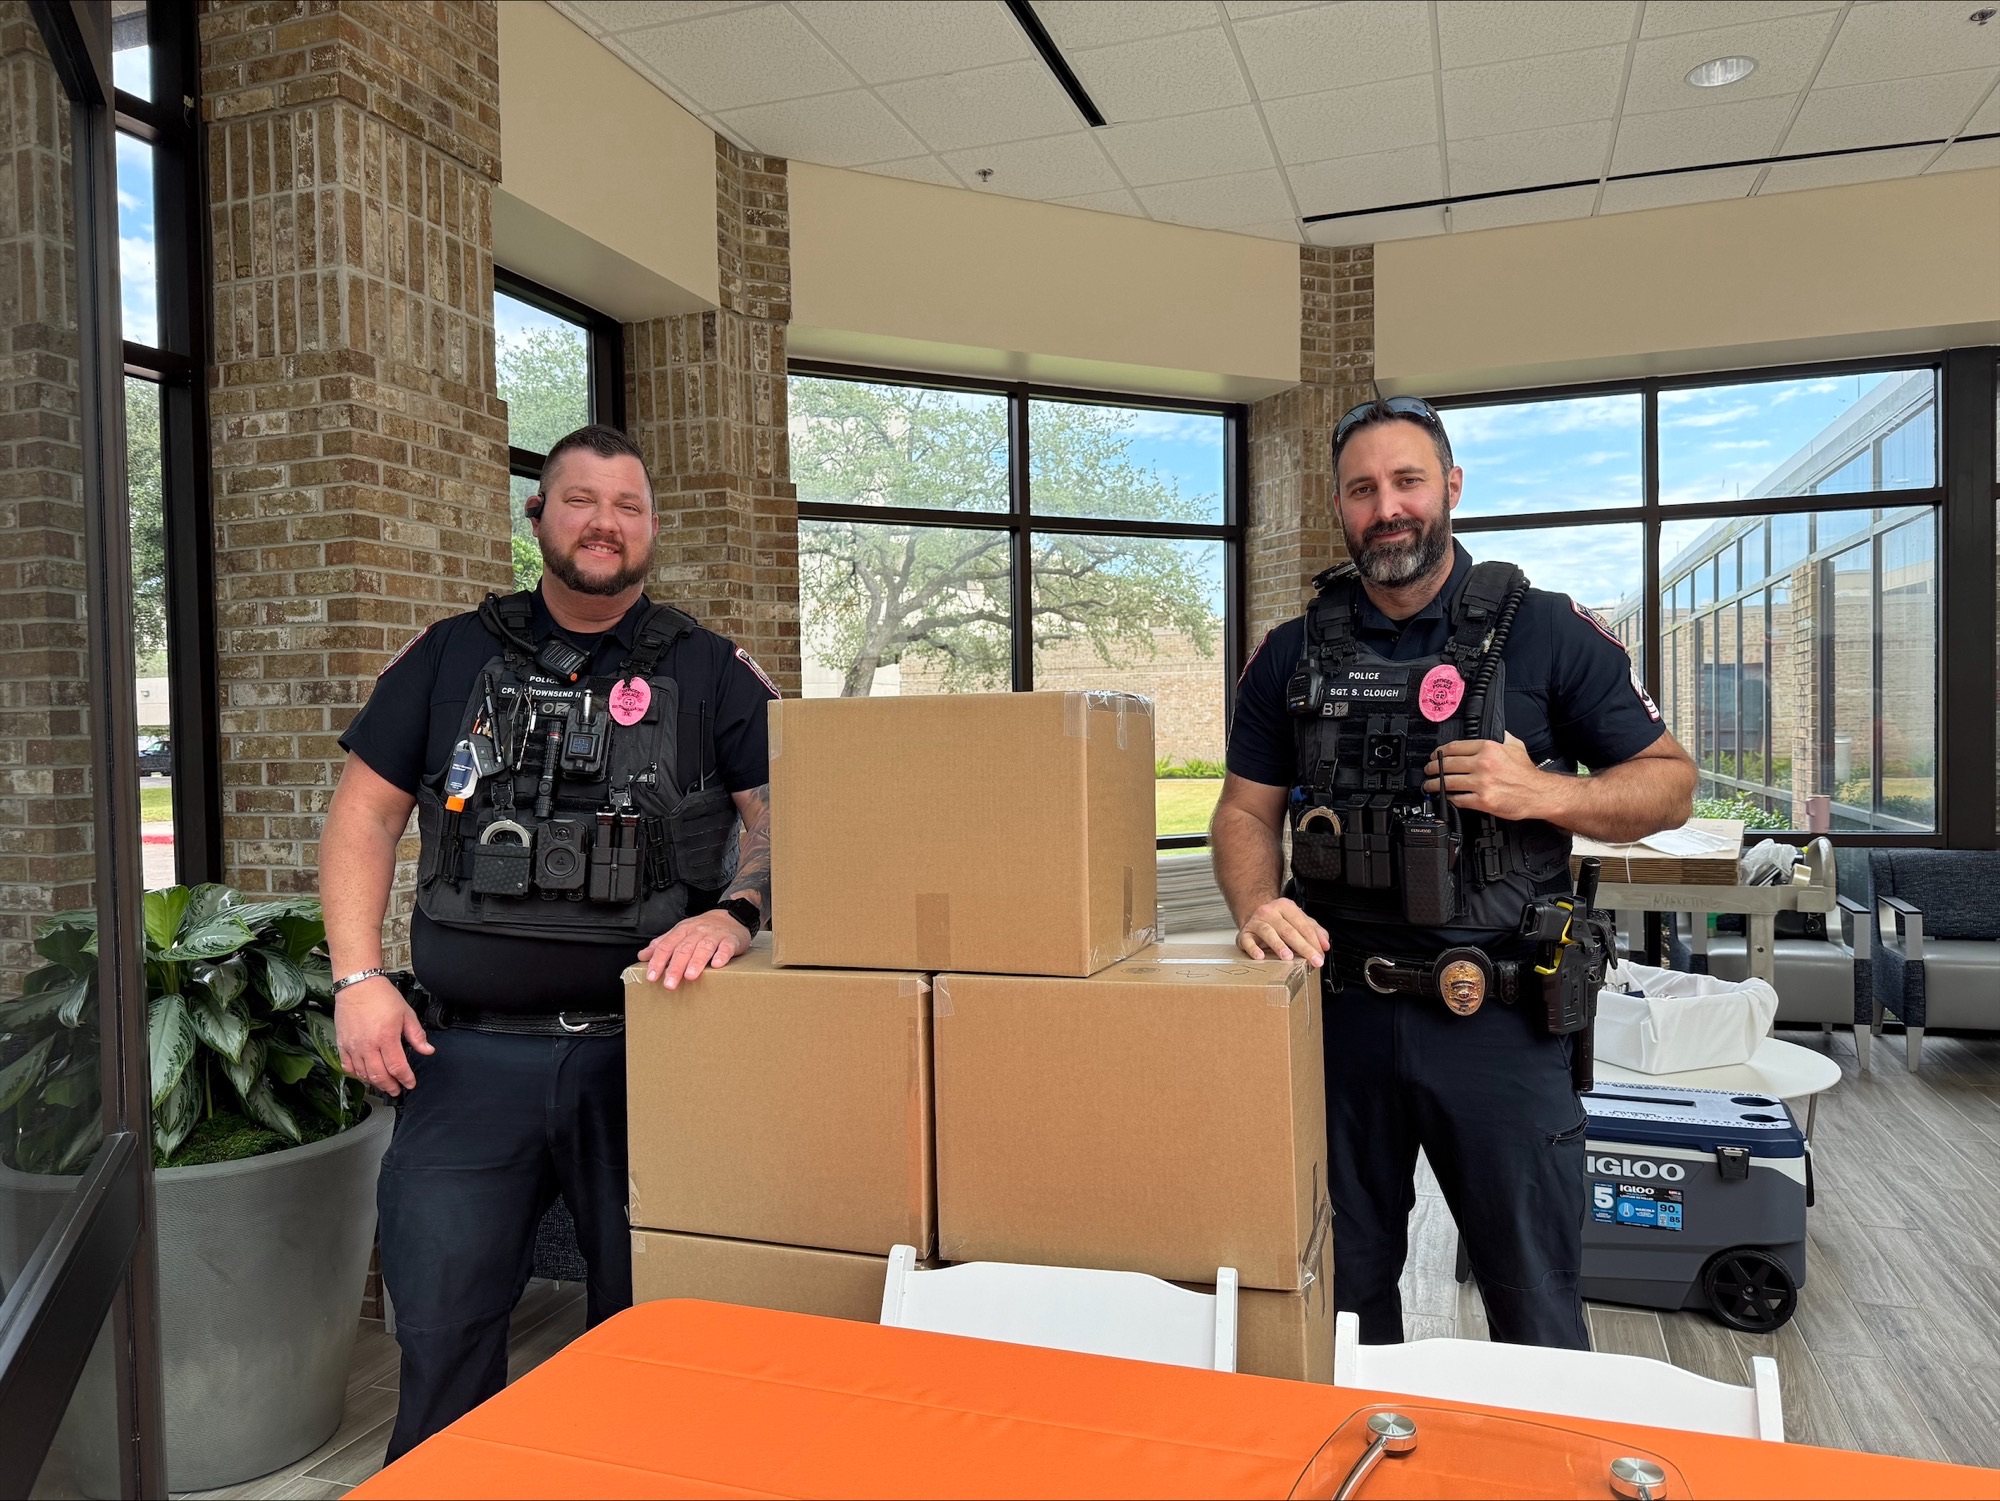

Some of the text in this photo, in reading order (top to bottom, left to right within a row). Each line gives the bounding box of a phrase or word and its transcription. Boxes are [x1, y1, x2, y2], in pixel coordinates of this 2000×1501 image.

[1348, 672, 1380, 680] POLICE
[532, 689, 573, 697] TOWNSEND
[1330, 688, 1399, 697] SGT. S. CLOUGH
[1322, 702, 1333, 715] B
[1653, 893, 1720, 909] MARKETING
[1586, 1155, 1686, 1181] IGLOO
[1620, 1184, 1655, 1195] IGLOO
[1594, 1186, 1614, 1209] 5
[1660, 1204, 1675, 1213] 90
